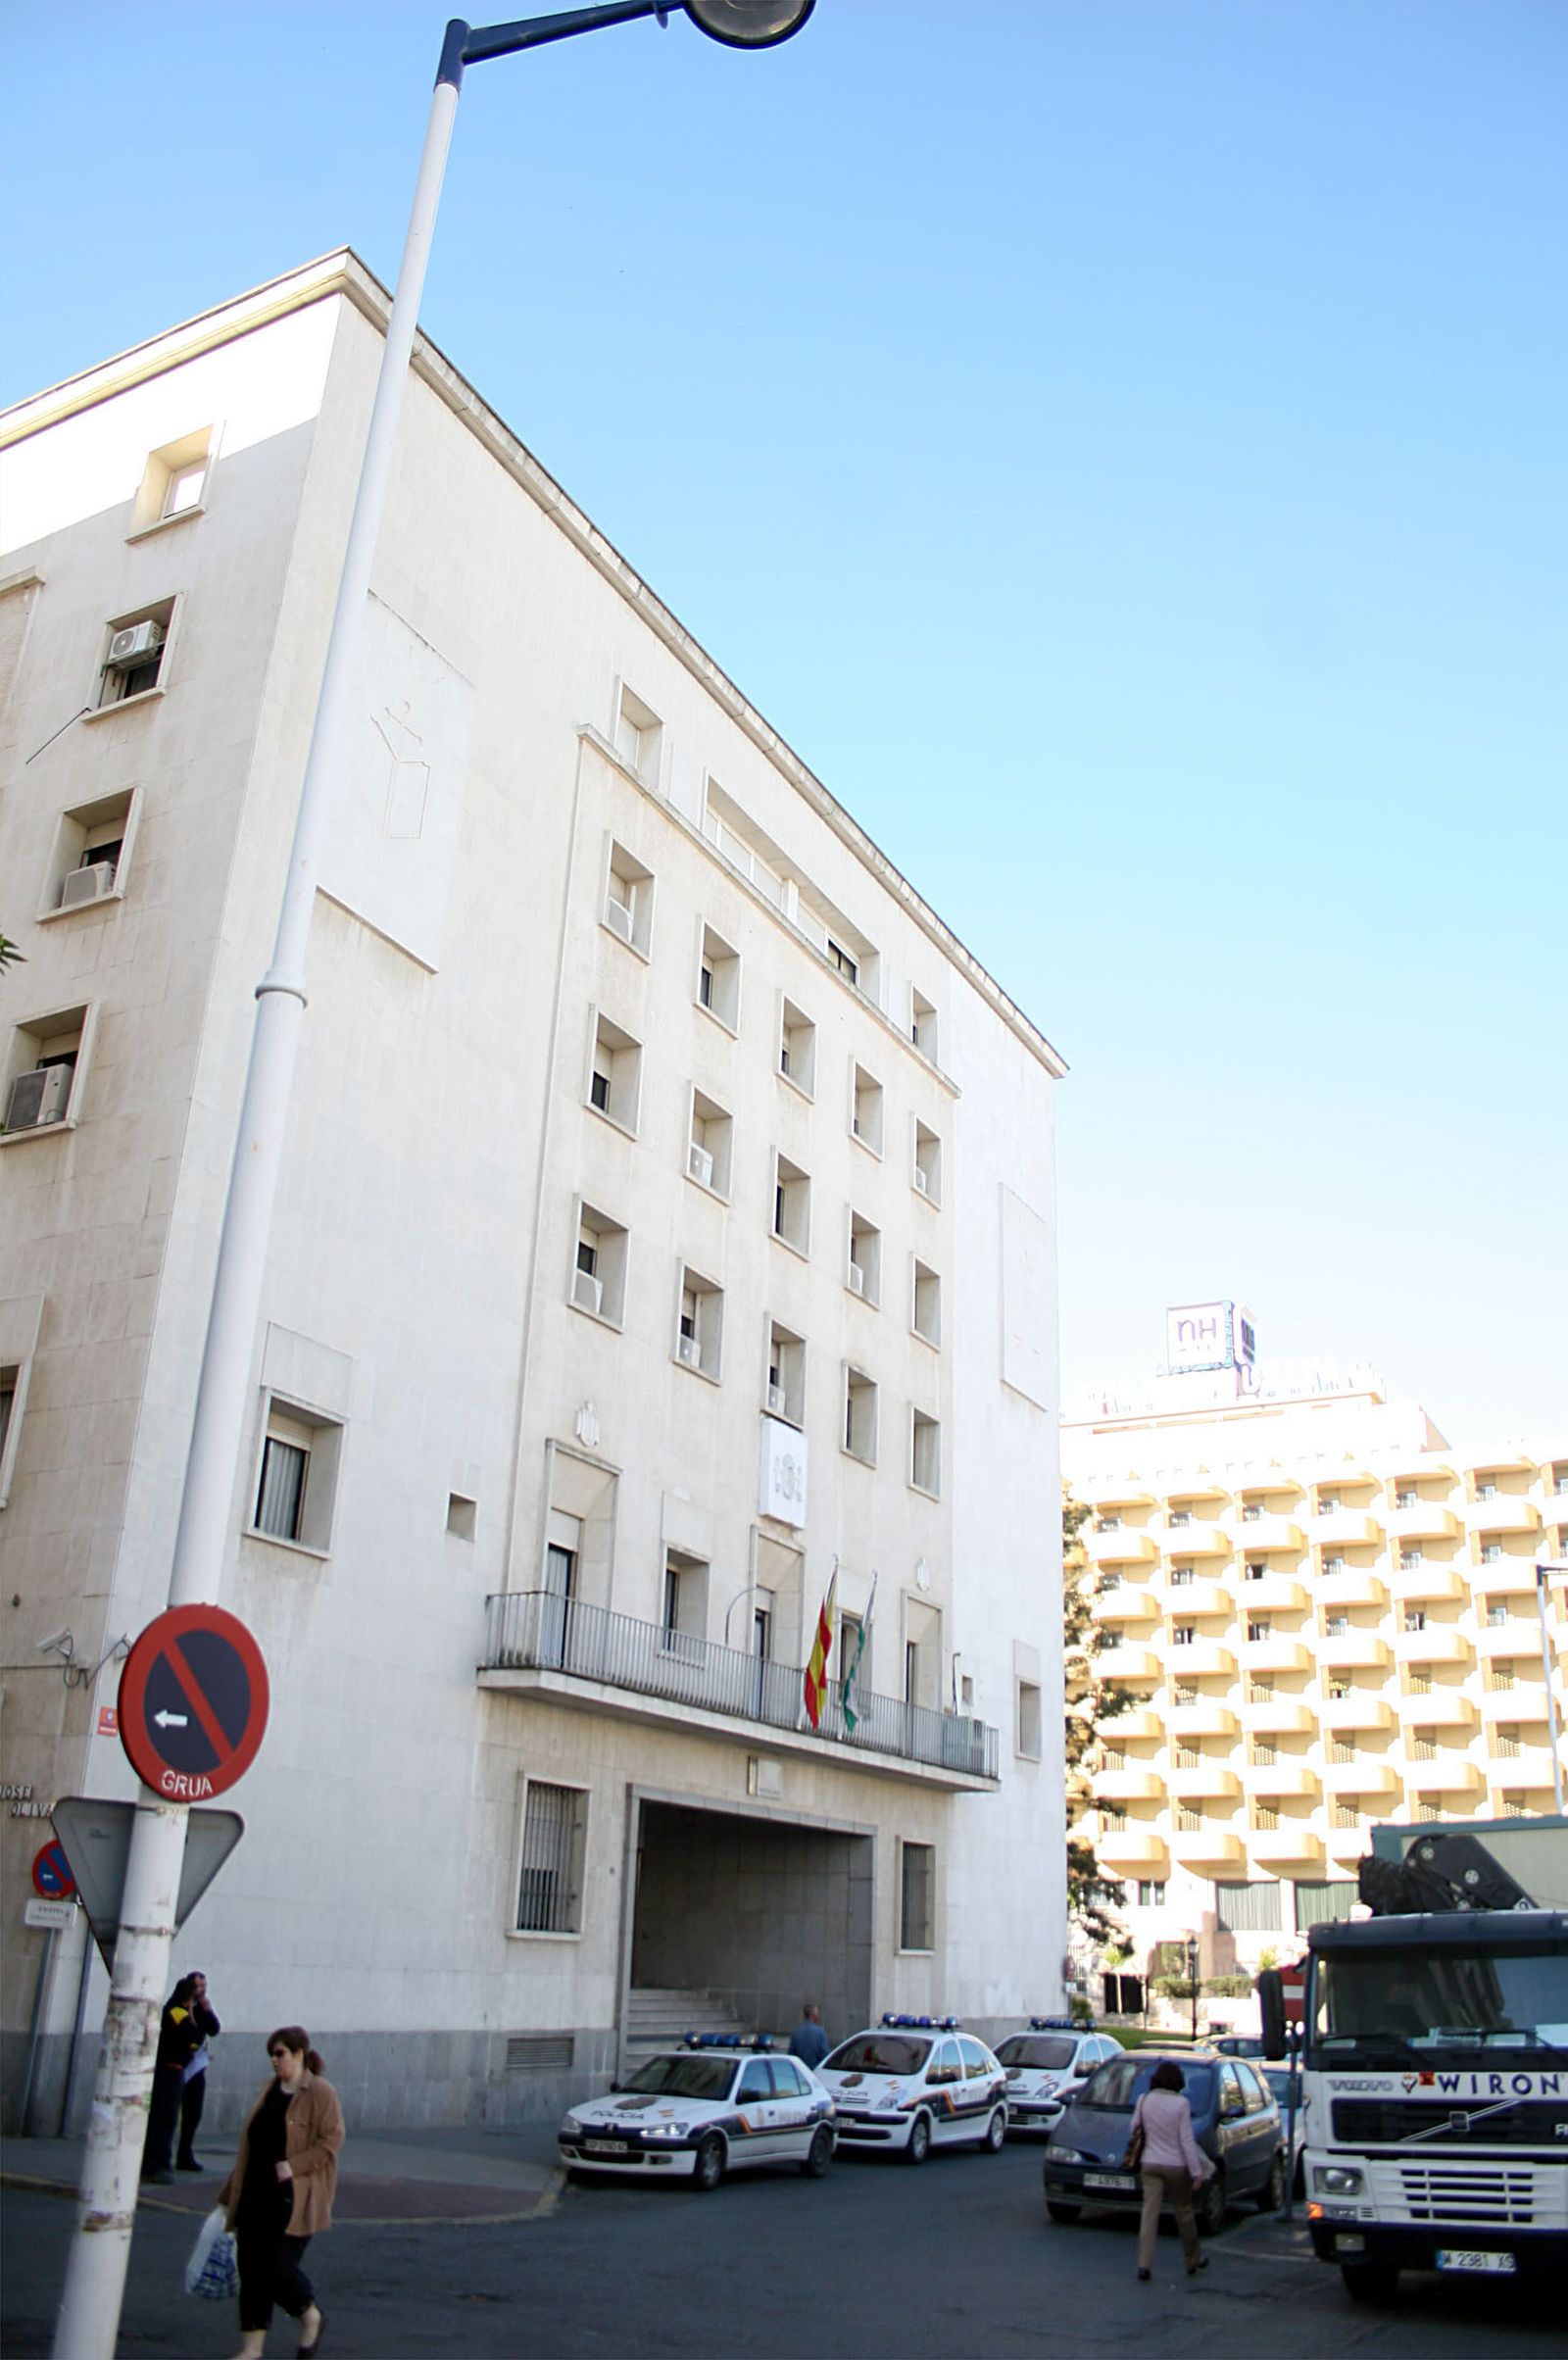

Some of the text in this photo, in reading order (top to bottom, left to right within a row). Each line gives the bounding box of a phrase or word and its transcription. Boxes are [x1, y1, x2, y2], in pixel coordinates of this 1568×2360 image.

[162, 1770, 213, 1796] GRUA
[1327, 2079, 1395, 2092] VOLVO
[1438, 2073, 1561, 2095] WIRON
